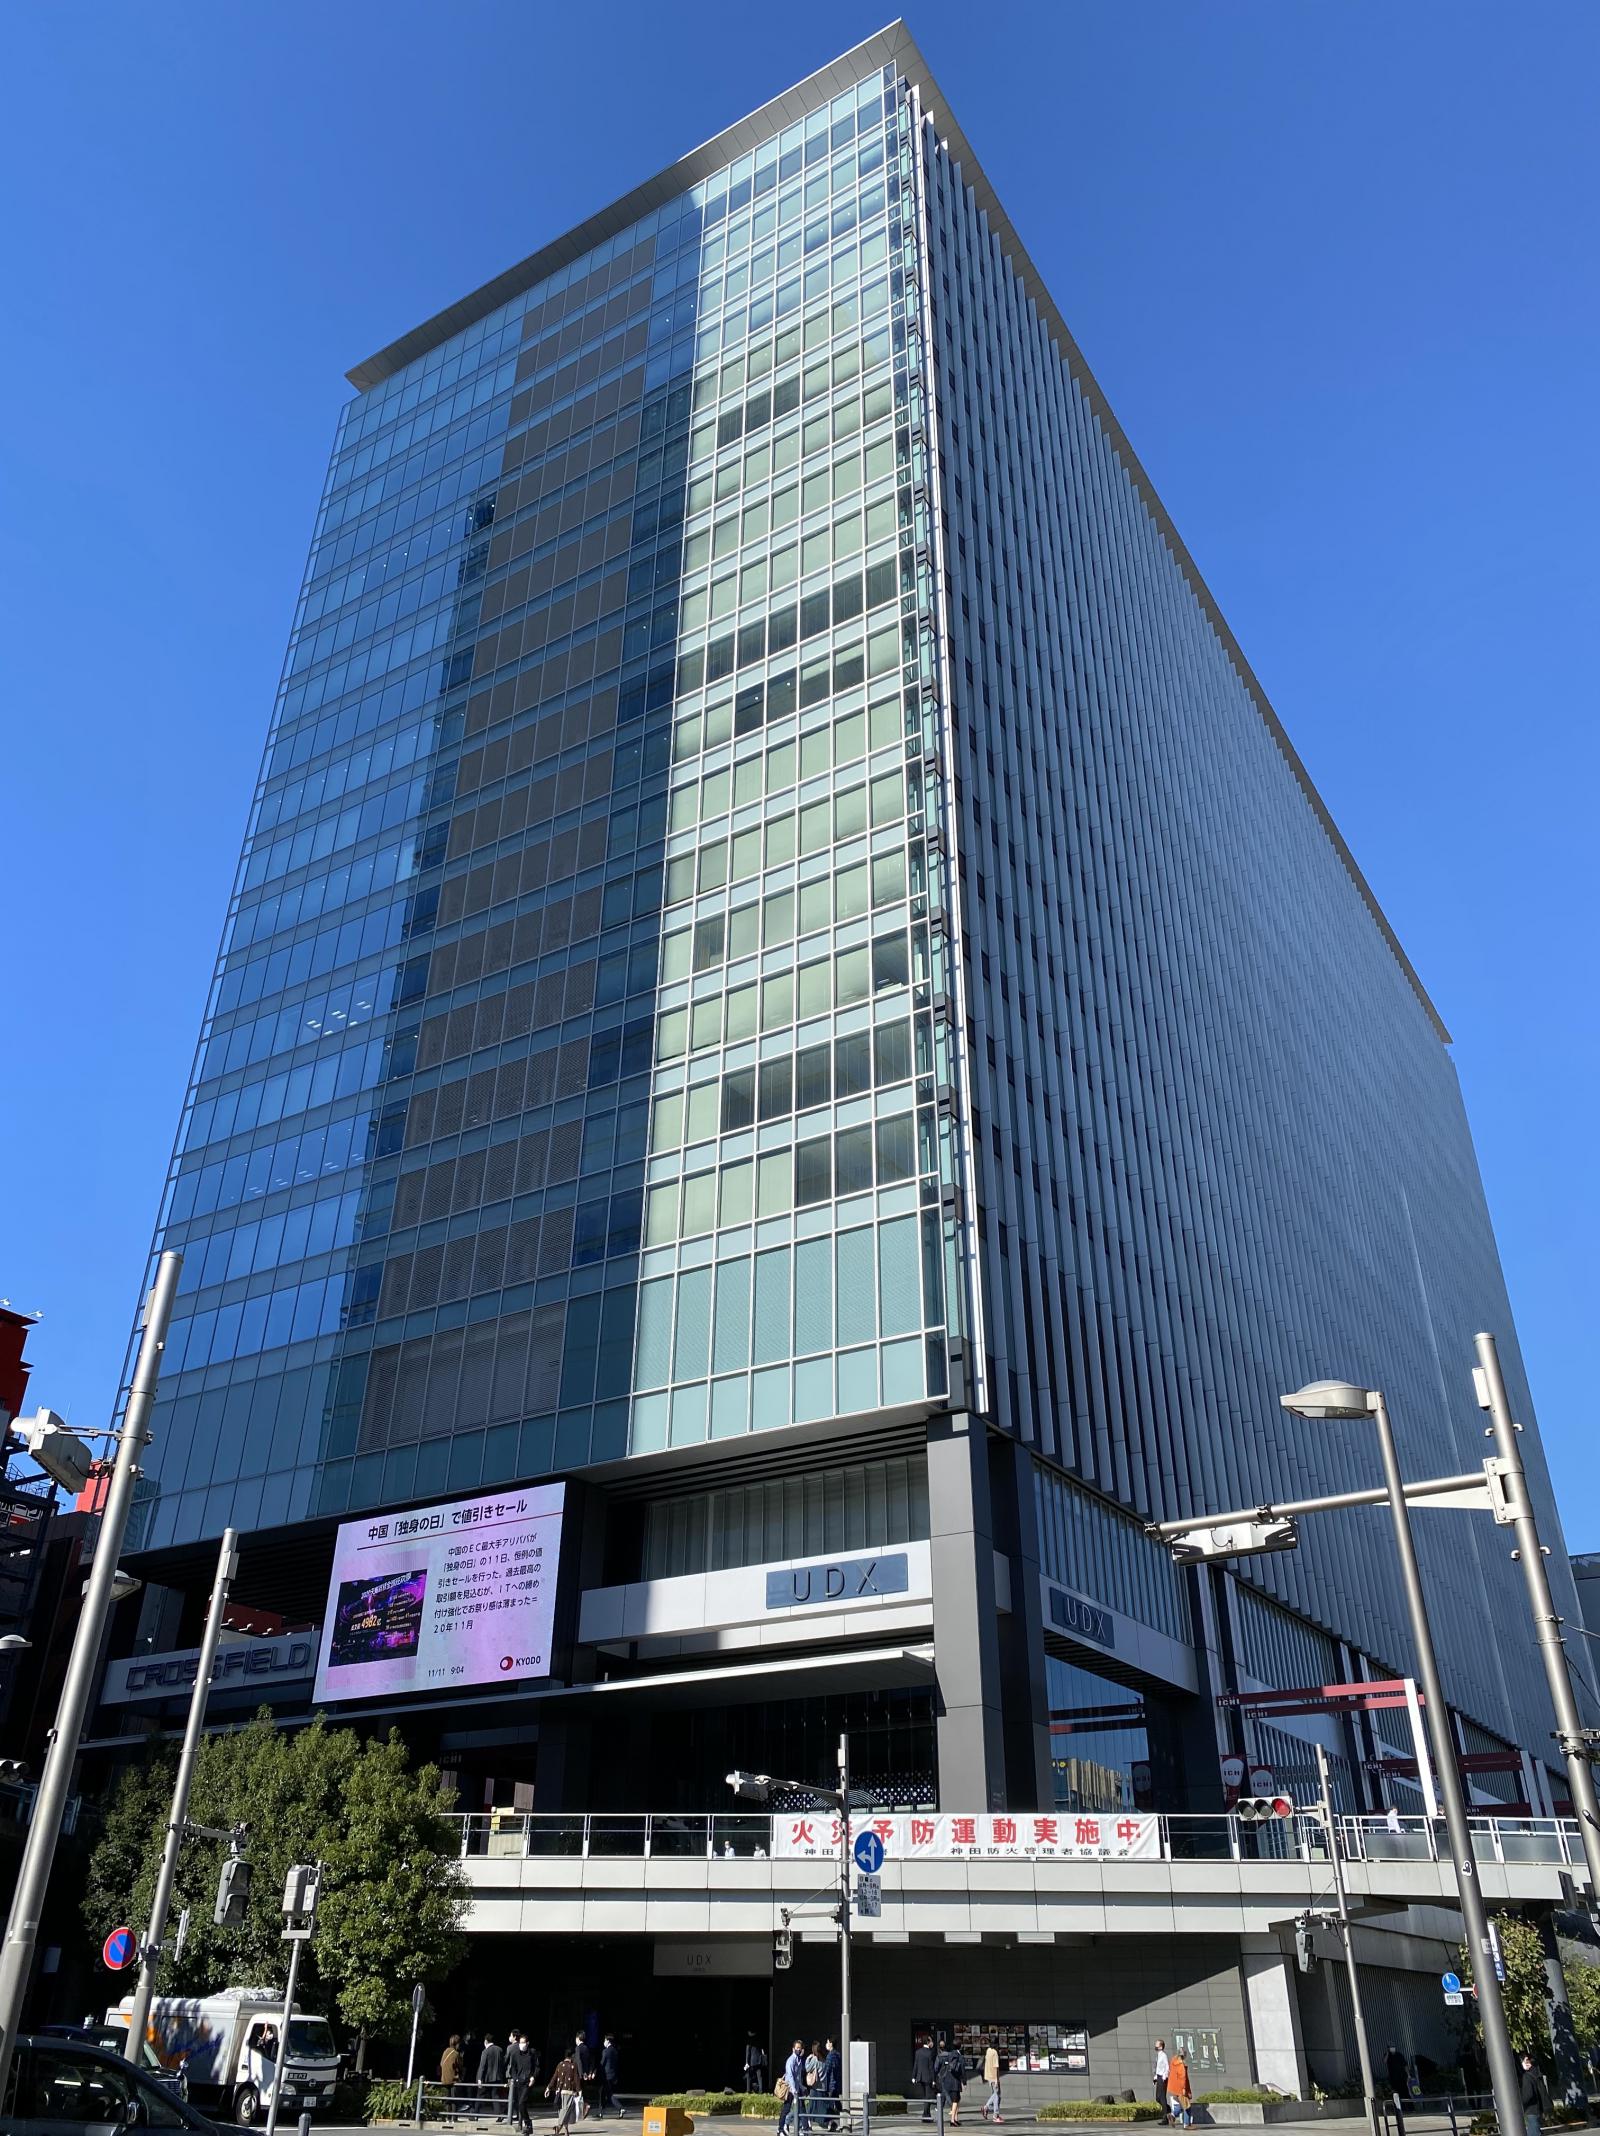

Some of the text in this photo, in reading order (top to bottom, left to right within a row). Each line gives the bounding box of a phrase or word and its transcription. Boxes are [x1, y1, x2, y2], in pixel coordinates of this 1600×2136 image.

[368, 1499, 528, 1541] 中国「独身の日」で値引きセール
[793, 1562, 878, 1602] UDX
[1066, 1597, 1106, 1639] UDX
[434, 1620, 474, 1634] 20年11月
[515, 1655, 541, 1667] KYODO
[428, 1666, 465, 1678] 11/11 9:04
[1218, 1698, 1240, 1707] ICHI
[1246, 1711, 1268, 1719] ICHI
[687, 1953, 712, 1965] UDX
